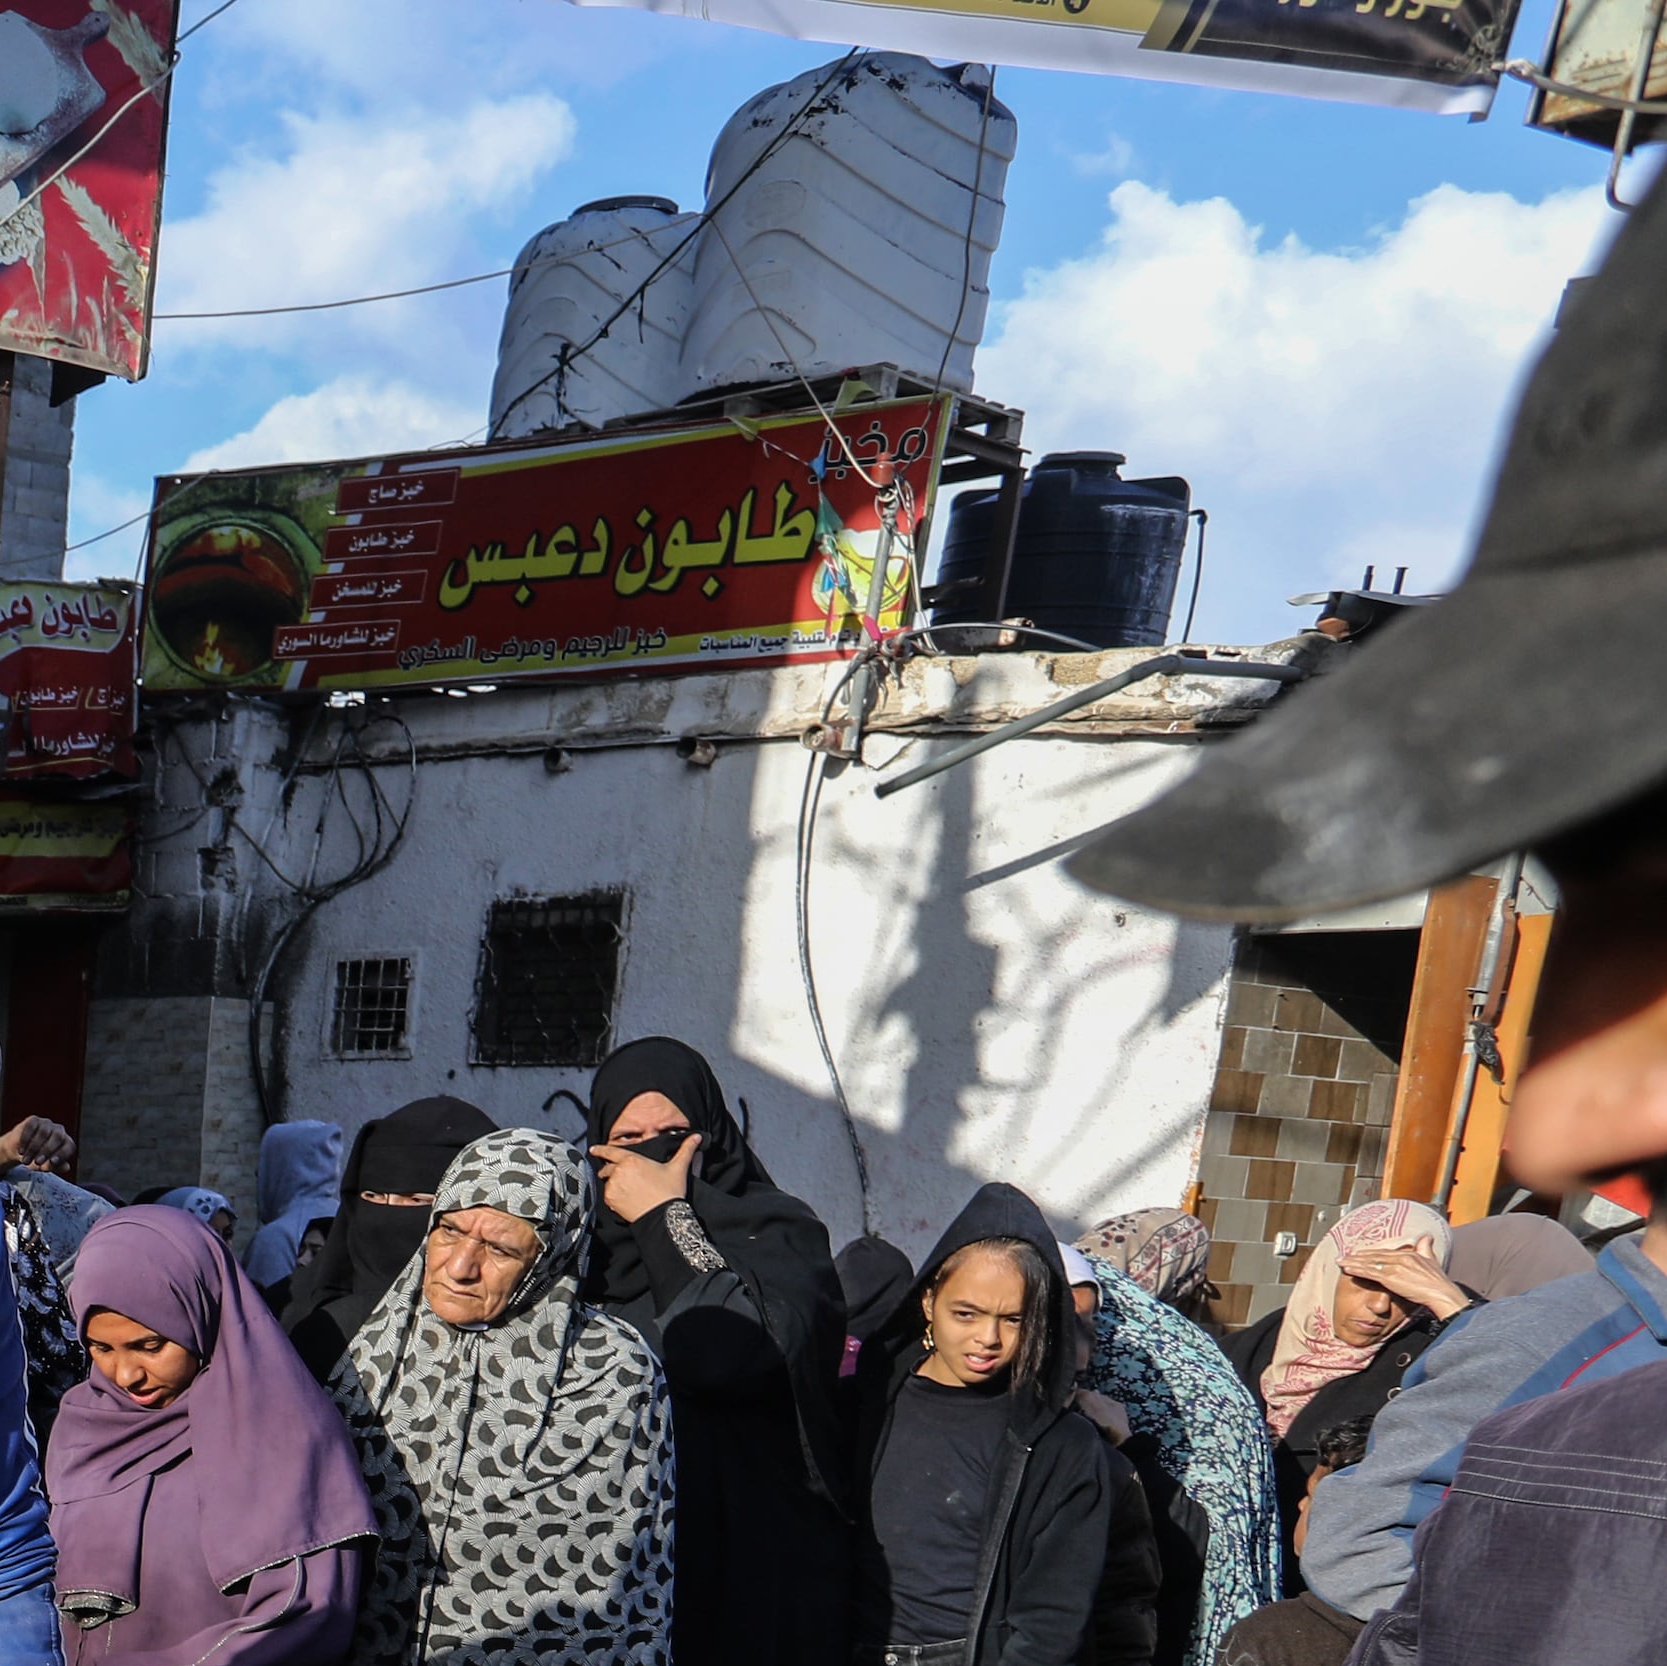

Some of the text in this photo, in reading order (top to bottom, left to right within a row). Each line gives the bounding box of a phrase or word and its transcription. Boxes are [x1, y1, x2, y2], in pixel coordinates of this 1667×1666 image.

[808, 420, 928, 484] مخبز
[368, 480, 425, 504] خبز صاج
[348, 529, 416, 552] خبز طابون
[438, 480, 817, 610] طابون دعبس
[378, 578, 403, 598] خبز
[40, 592, 120, 643] طابون
[277, 627, 396, 654] خبز للشاورما السوري
[397, 626, 668, 671] خبز للرجيم ومرضى السكري
[699, 635, 757, 653] المناسبات
[758, 635, 789, 653] جميع
[20, 685, 79, 706] خبز طابون
[41, 731, 99, 756] للشاورما
